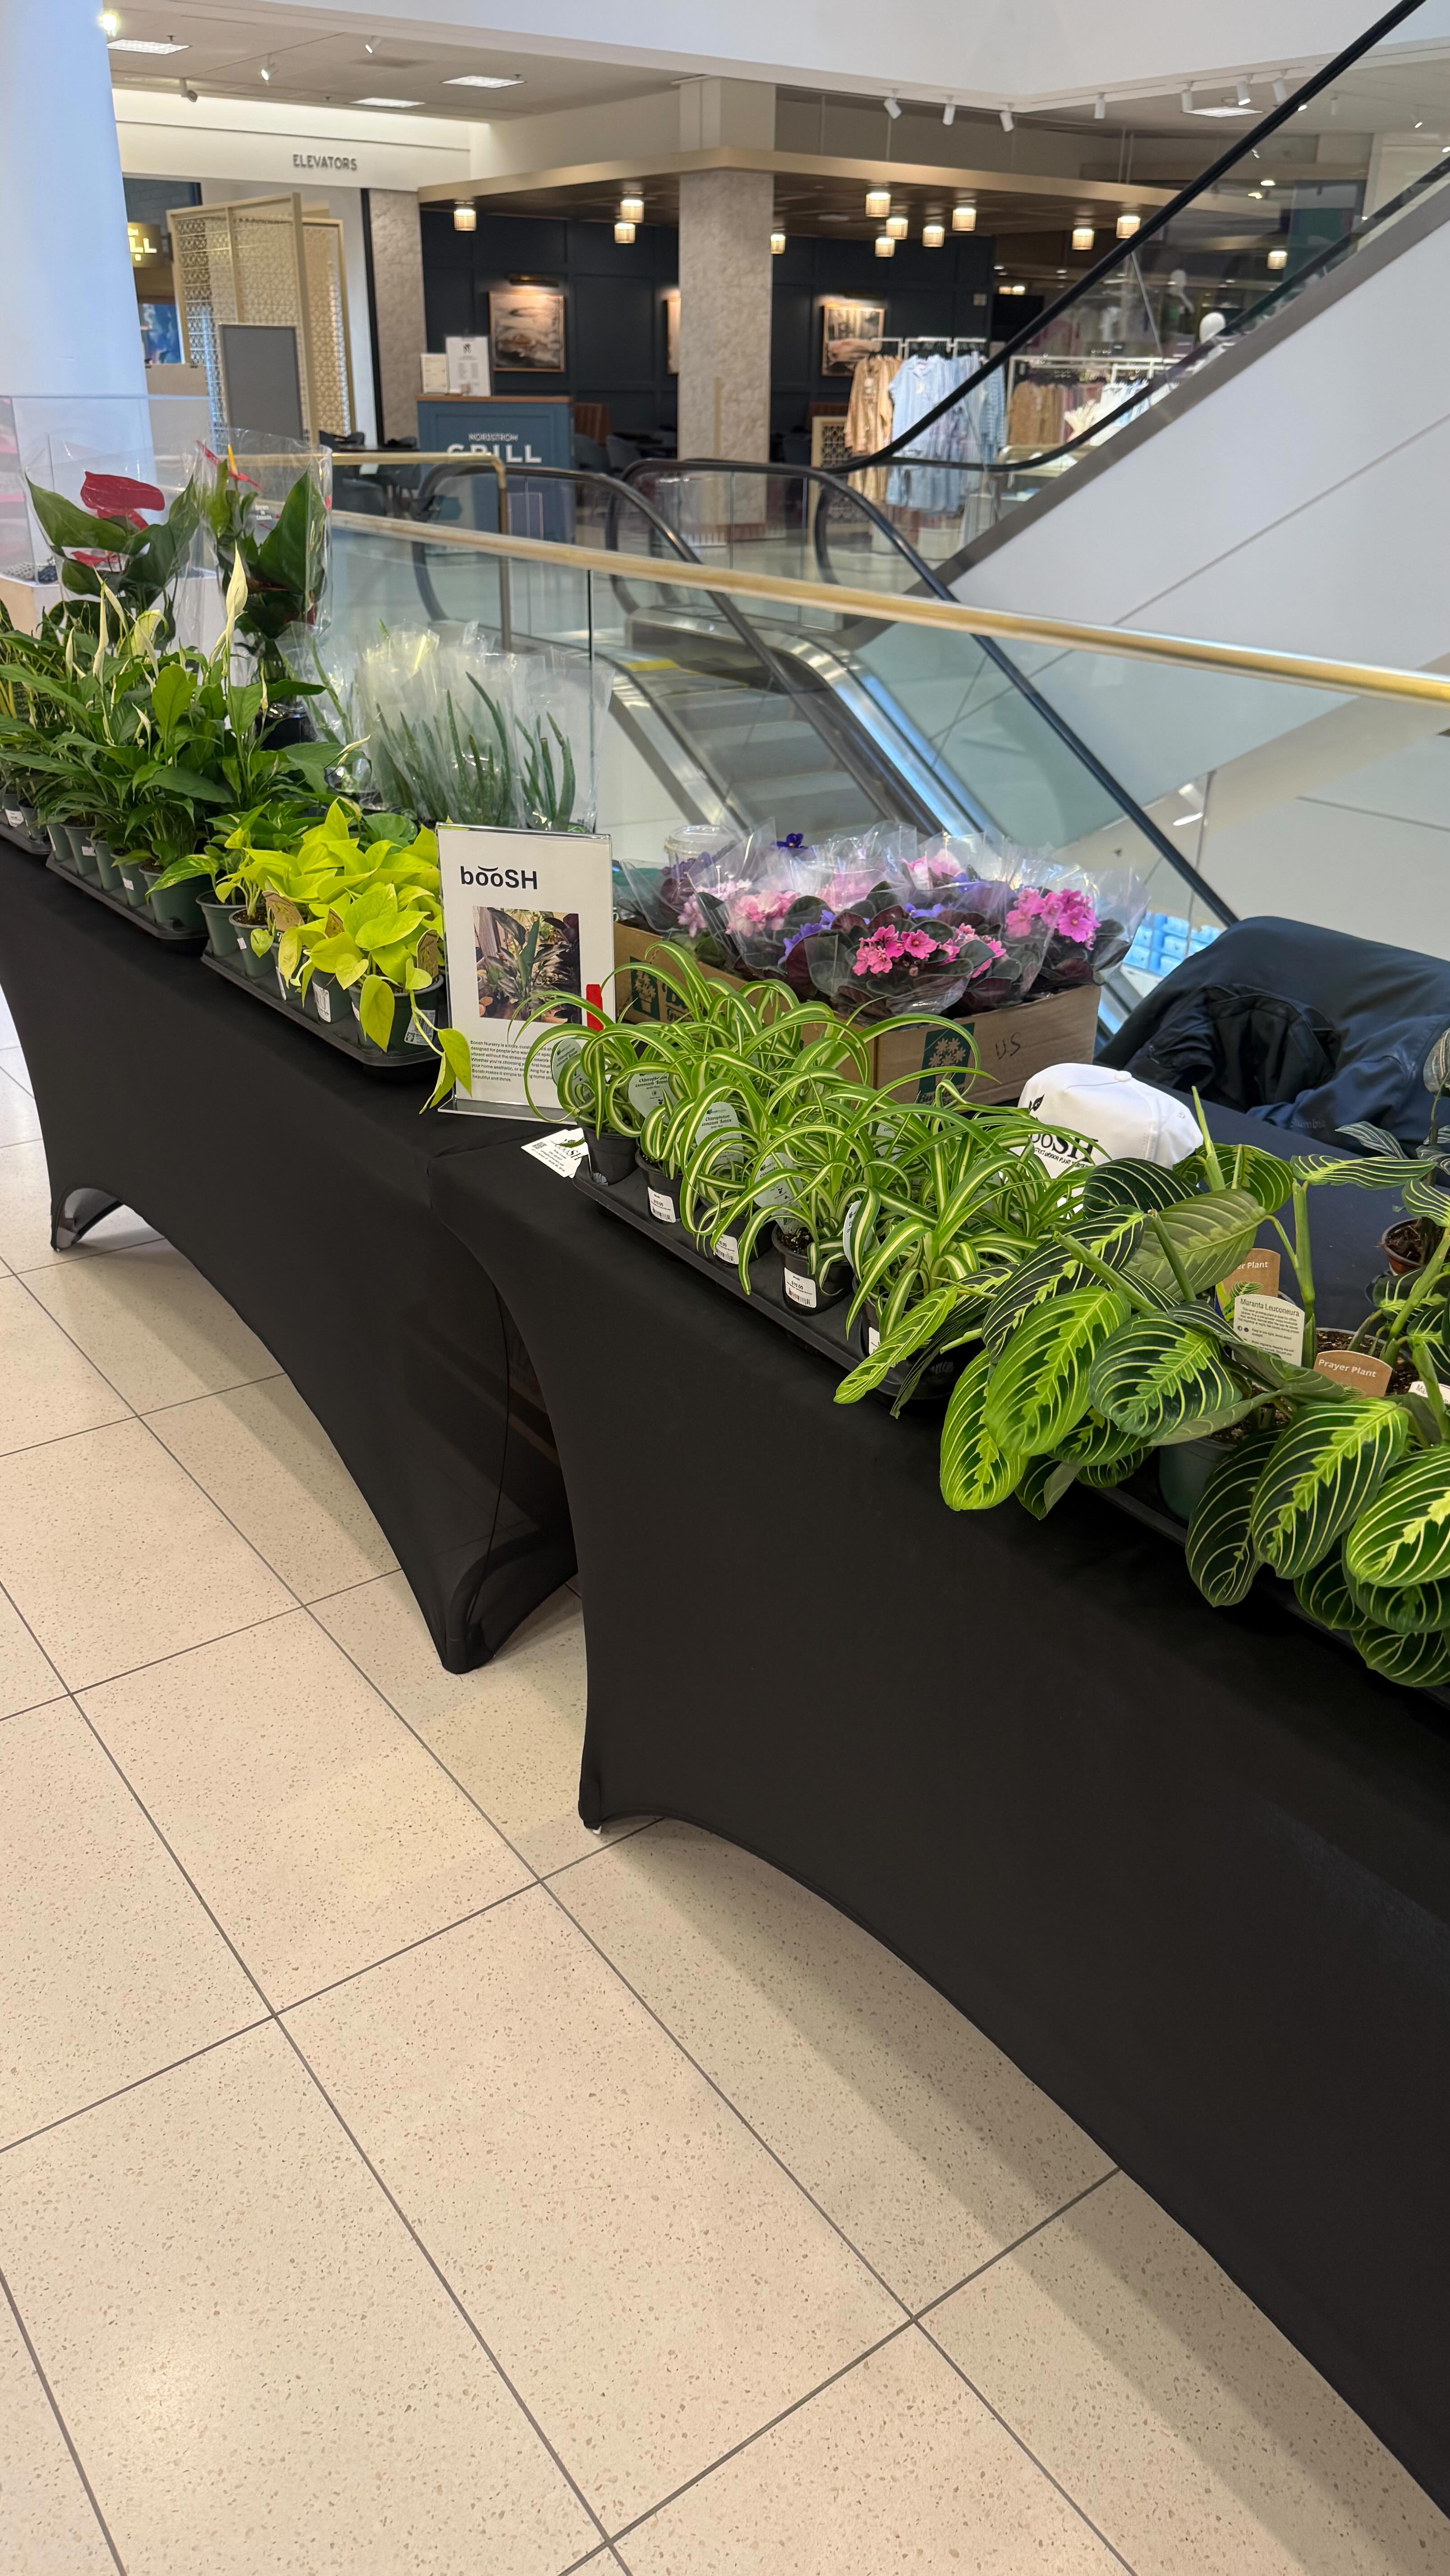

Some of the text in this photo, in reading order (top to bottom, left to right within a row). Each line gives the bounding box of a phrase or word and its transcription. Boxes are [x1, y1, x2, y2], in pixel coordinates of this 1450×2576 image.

[293, 154, 357, 170] ELEVATORS
[995, 1031, 1021, 1060] US
[1030, 1132, 1099, 1164] ooSH
[1240, 1298, 1263, 1309] Maranta
[1318, 1359, 1377, 1378] Prayer Plant
